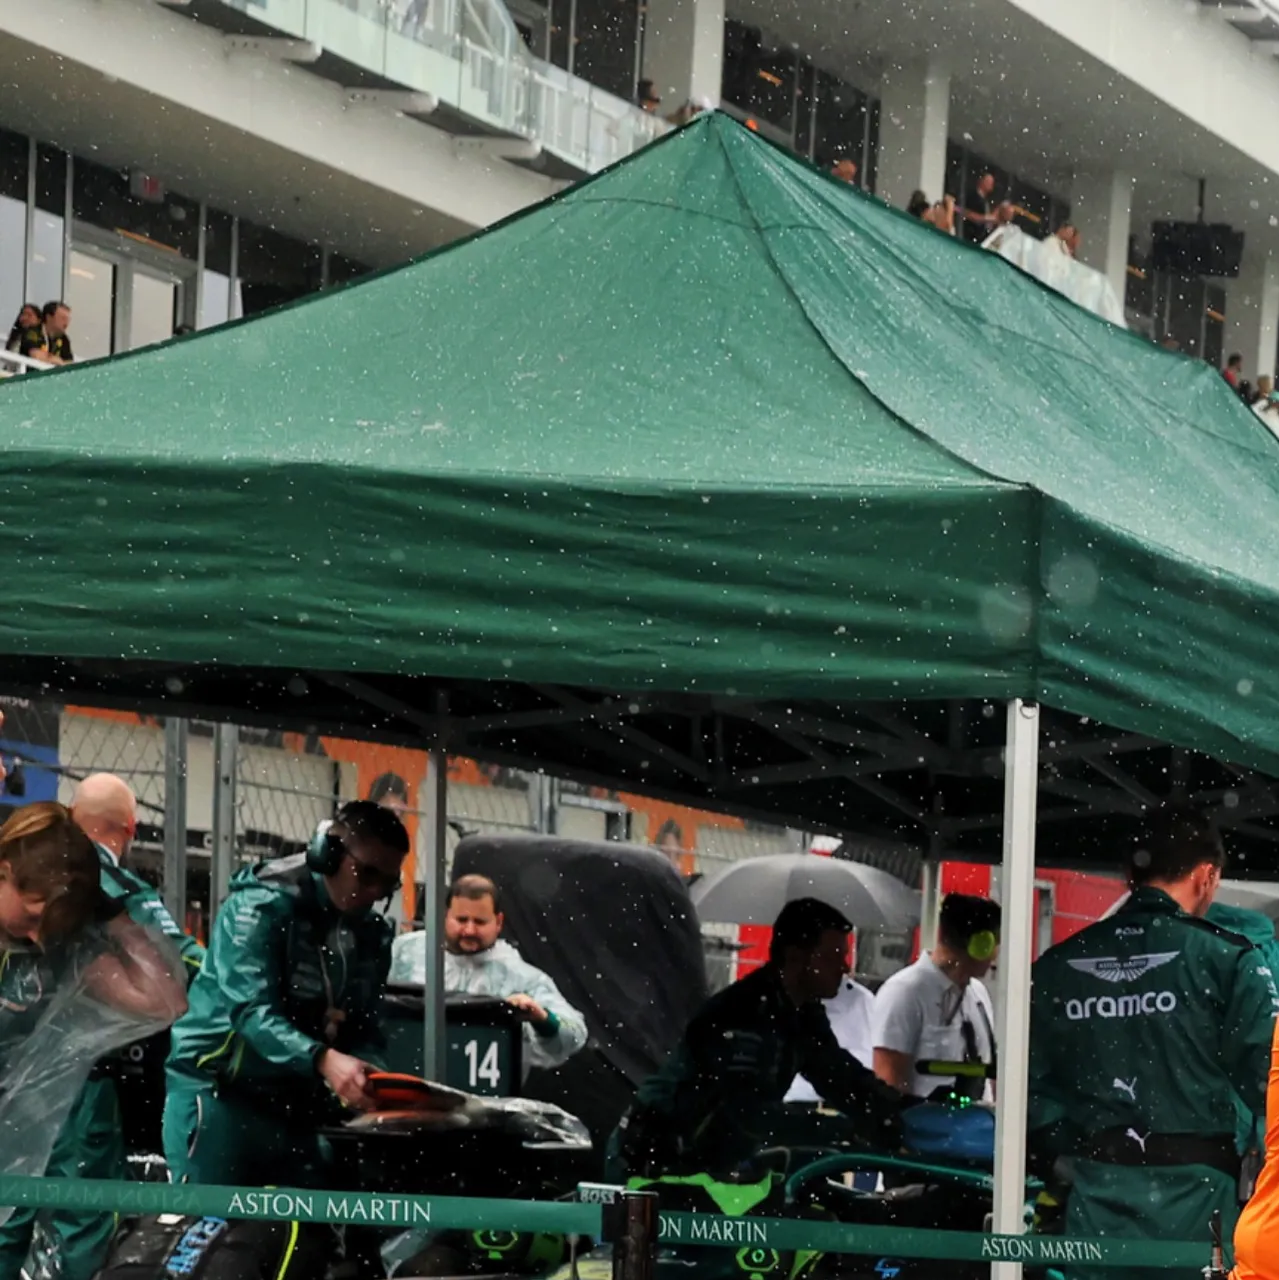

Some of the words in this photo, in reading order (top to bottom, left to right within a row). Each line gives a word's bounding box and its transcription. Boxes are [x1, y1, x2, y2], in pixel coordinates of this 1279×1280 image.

[1065, 990, 1177, 1021] aramco
[463, 1040, 501, 1088] 14
[228, 1192, 313, 1218] ASTON
[325, 1198, 432, 1223] MARTIN
[690, 1217, 768, 1242] MARTIN
[981, 1237, 1035, 1258] ASTON
[1040, 1240, 1102, 1261] MARTIN
